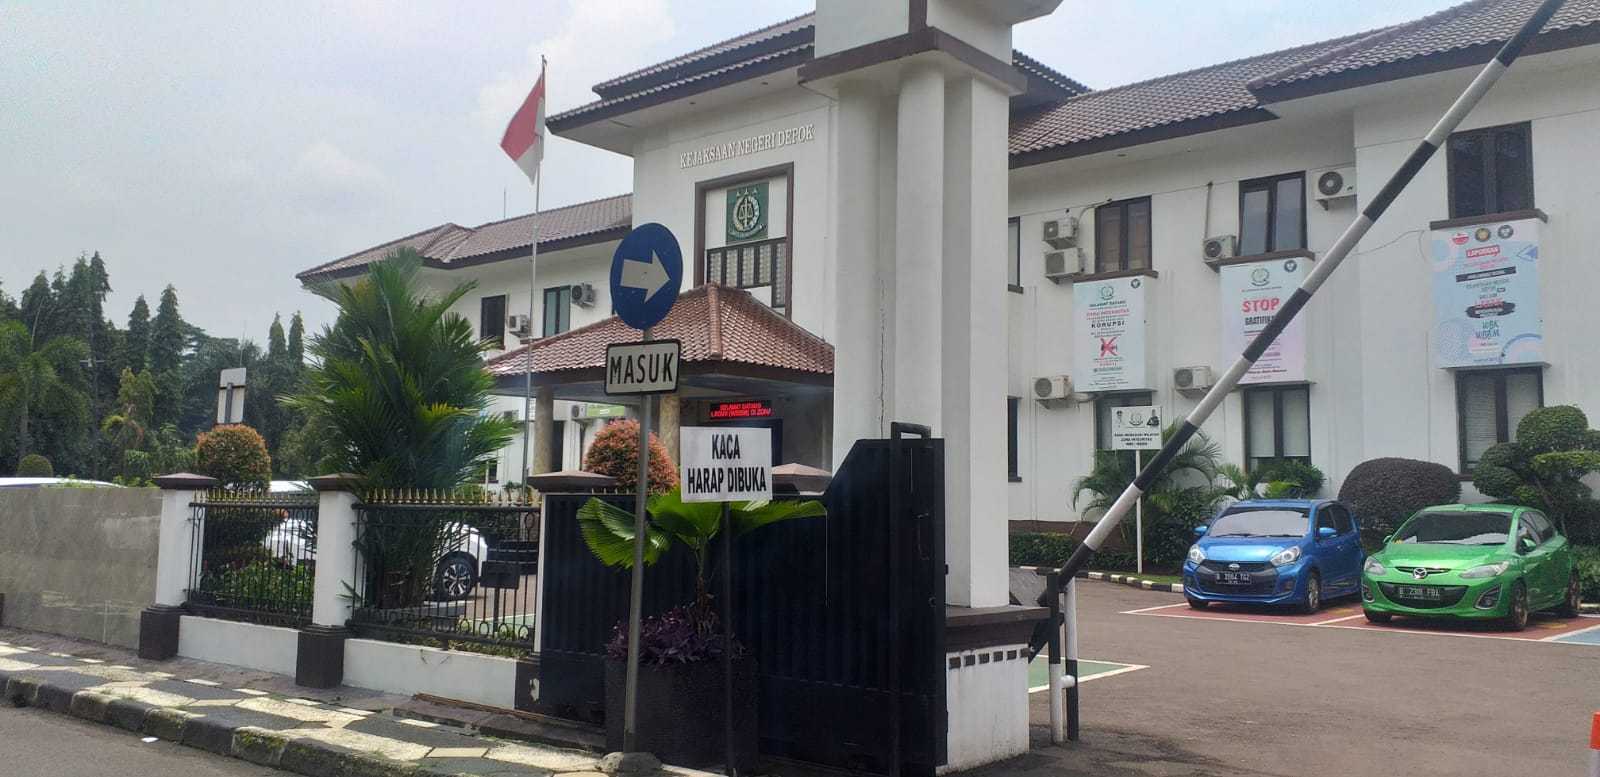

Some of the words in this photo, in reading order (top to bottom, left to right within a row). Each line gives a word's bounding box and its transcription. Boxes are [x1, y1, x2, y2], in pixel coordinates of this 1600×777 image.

[680, 141, 737, 169] KEJAKSAAN
[738, 132, 776, 157] NEGERI
[778, 123, 815, 147] DEPOK
[1242, 297, 1280, 313] STOP
[1091, 320, 1125, 329] KORUPSI
[609, 352, 674, 385] MASUK
[711, 434, 741, 460] KACA
[687, 468, 724, 494] HARAP
[727, 466, 767, 493] DIBUKA
